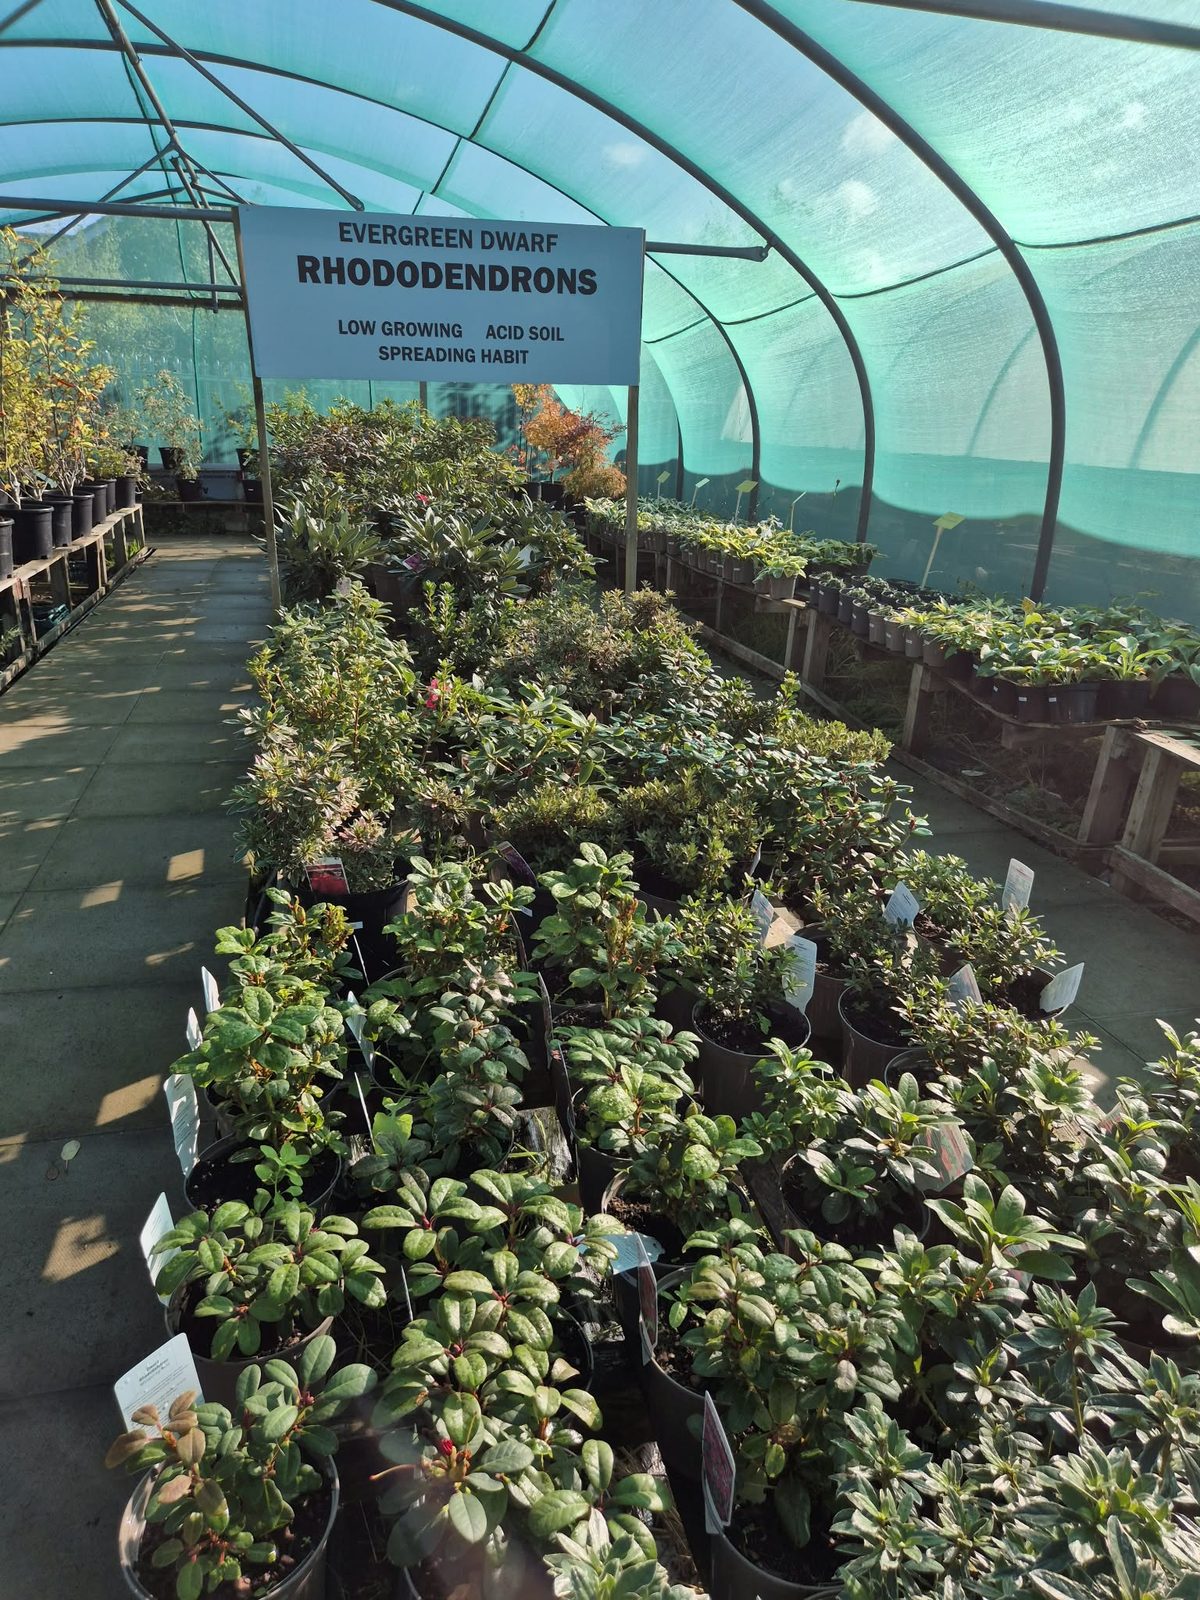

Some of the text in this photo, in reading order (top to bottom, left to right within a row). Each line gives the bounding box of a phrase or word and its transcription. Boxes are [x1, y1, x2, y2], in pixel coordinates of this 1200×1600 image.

[339, 222, 558, 253] EVERGREEN DWARF
[297, 255, 598, 296] RHODODENDRONS
[338, 319, 463, 338] LOW GROWING
[486, 324, 565, 342] ACID SOIL
[379, 346, 529, 364] SPREADING HABIT
